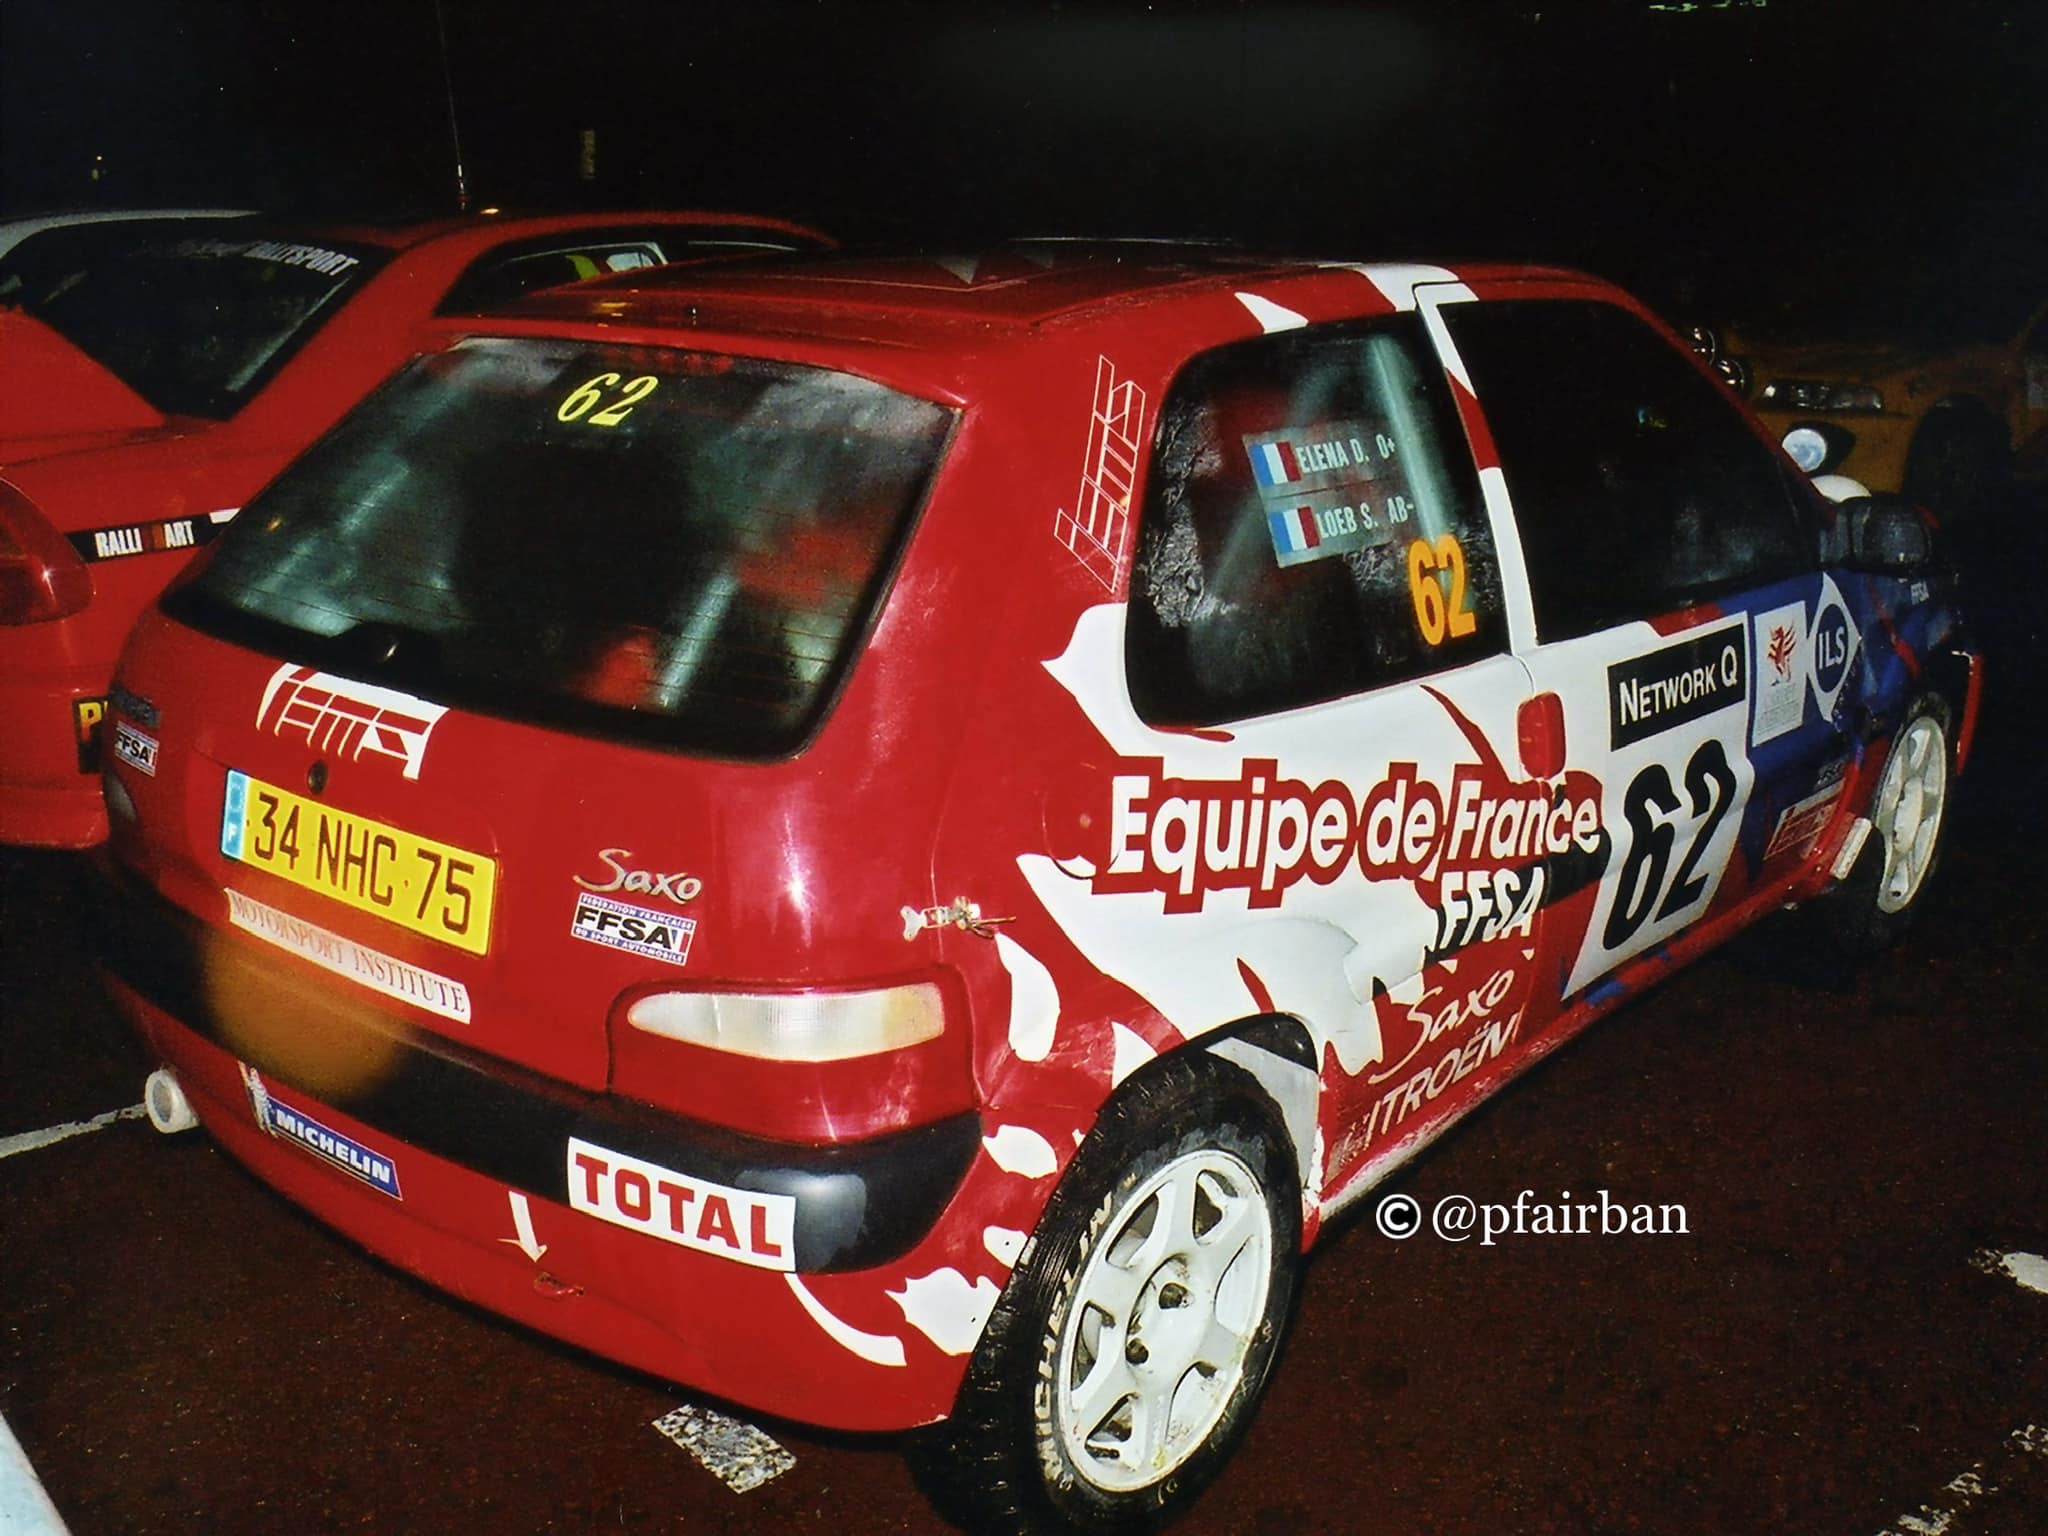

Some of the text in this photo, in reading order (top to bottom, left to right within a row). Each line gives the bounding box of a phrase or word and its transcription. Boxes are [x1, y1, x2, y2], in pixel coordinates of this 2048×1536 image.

[556, 372, 659, 427] 62
[1296, 441, 1349, 474] ELENA
[1350, 438, 1369, 464] D.
[1316, 496, 1414, 539] LOEB S. AB-
[1409, 534, 1476, 646] 62
[1619, 673, 1717, 727] NETWORK
[1720, 645, 1739, 688] Q
[1819, 626, 1846, 671] ILS
[227, 823, 238, 842] F
[254, 791, 475, 935] 34 NHC 75
[1106, 775, 1601, 890] Equipe de France
[1602, 738, 1737, 951] 62
[572, 848, 702, 904] Saxo
[1438, 866, 1545, 950] FFSA
[231, 893, 465, 1013] MOTORSPORT INSTITUTE
[576, 905, 673, 950] FFSA
[1368, 968, 1515, 1084] Saxo
[1343, 1012, 1521, 1152] ITROËN
[276, 1108, 391, 1184] MICHELIN
[574, 1151, 783, 1258] TOTAL
